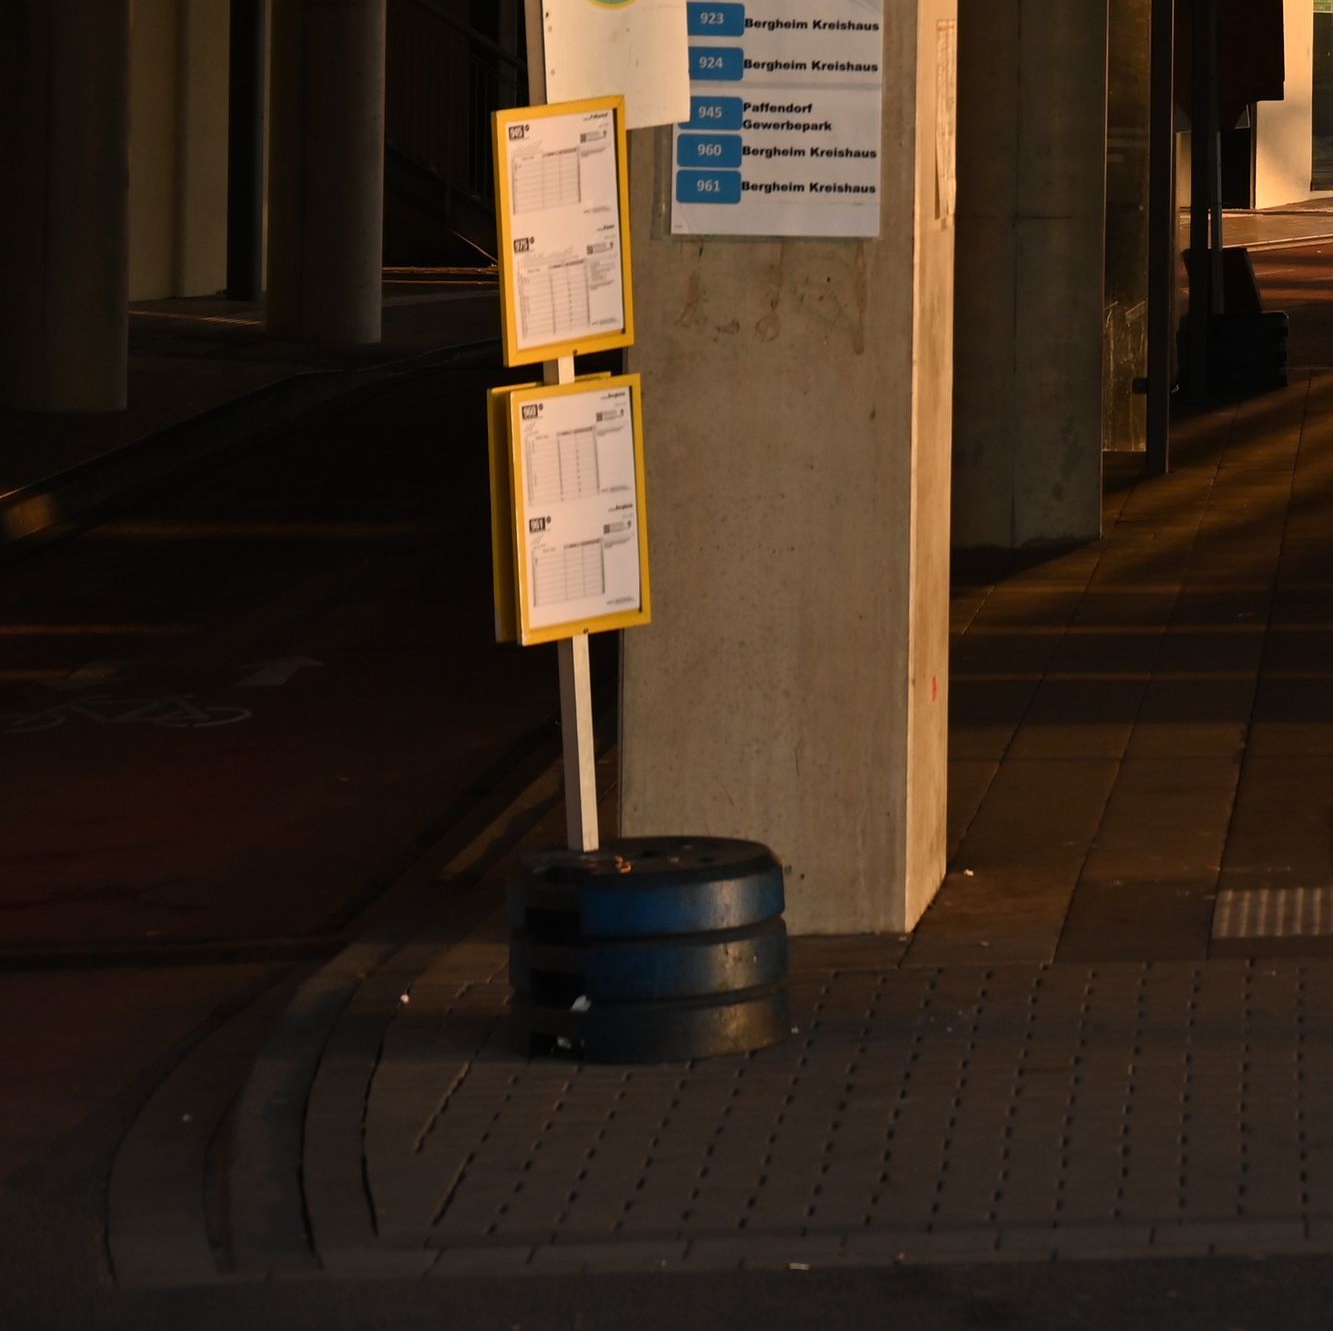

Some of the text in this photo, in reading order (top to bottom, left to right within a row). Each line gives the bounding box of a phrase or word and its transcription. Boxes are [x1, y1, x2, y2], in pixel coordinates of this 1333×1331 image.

[700, 12, 725, 25] 923
[745, 18, 880, 31] Bergheim Kreishaus
[699, 56, 724, 69] 924
[743, 59, 879, 72] Bergheim Kreishaus
[698, 106, 723, 119] 945
[743, 102, 813, 114] Paffendorf
[743, 119, 833, 133] Gewerbepark
[698, 144, 723, 157] 960
[742, 145, 877, 159] Bergheim Kreishaus
[697, 180, 721, 193] 961
[742, 181, 876, 194] Bergheim Kreishaus
